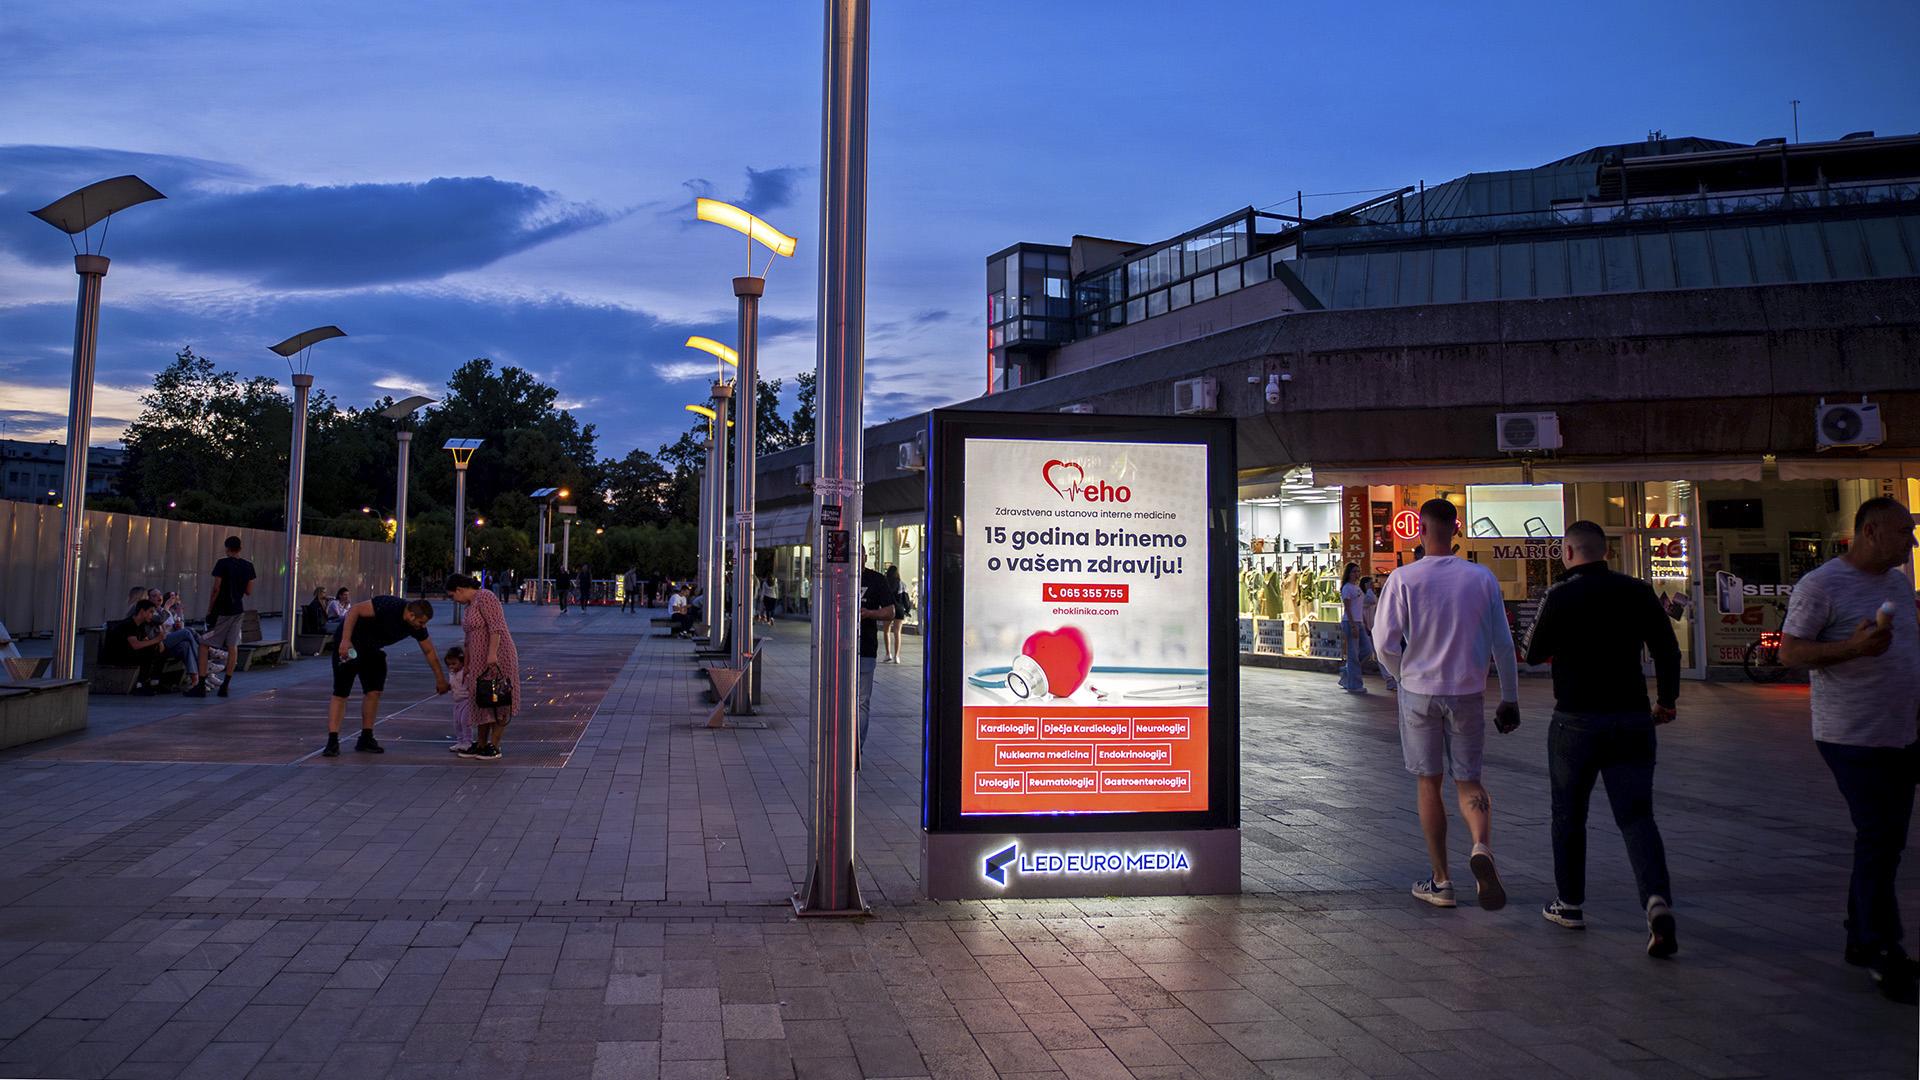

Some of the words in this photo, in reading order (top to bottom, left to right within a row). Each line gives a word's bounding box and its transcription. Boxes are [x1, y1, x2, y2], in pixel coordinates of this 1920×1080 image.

[1083, 480, 1132, 502] eho
[995, 507, 1052, 517] Zdravstvena
[1054, 509, 1098, 518] ustanova
[1100, 510, 1132, 519] interne
[1134, 510, 1177, 520] medicine
[1349, 496, 1362, 540] IZRADA
[984, 527, 1007, 544] 15
[1011, 528, 1090, 550] godina
[1095, 529, 1187, 548] brinemo
[1492, 539, 1562, 560] MARIĆ
[987, 557, 1001, 572] o
[1006, 554, 1082, 573] vašem
[1087, 556, 1183, 579] zdravlju!
[1059, 588, 1080, 599] 065
[1082, 588, 1102, 599] 355
[1103, 588, 1124, 599] 755
[1743, 584, 1792, 596] SER
[1052, 607, 1119, 617] ehoklinika.com
[1719, 647, 1758, 660] SERVS
[980, 723, 1035, 735] Kardiologija
[1044, 723, 1072, 735] Dječja
[1073, 723, 1127, 735] Kardiologija
[1136, 723, 1186, 735] Neurologija
[999, 751, 1045, 759] Nuklearna
[1047, 750, 1089, 759] medicina
[1099, 749, 1167, 761] Endokrinologija
[979, 778, 1020, 789] Urologija
[1029, 777, 1094, 788] Reumatologija
[1104, 777, 1187, 788] Gastroenterologija
[1021, 856, 1063, 872] LED
[1067, 855, 1122, 871] EURO
[1126, 854, 1189, 870] MEDIA
